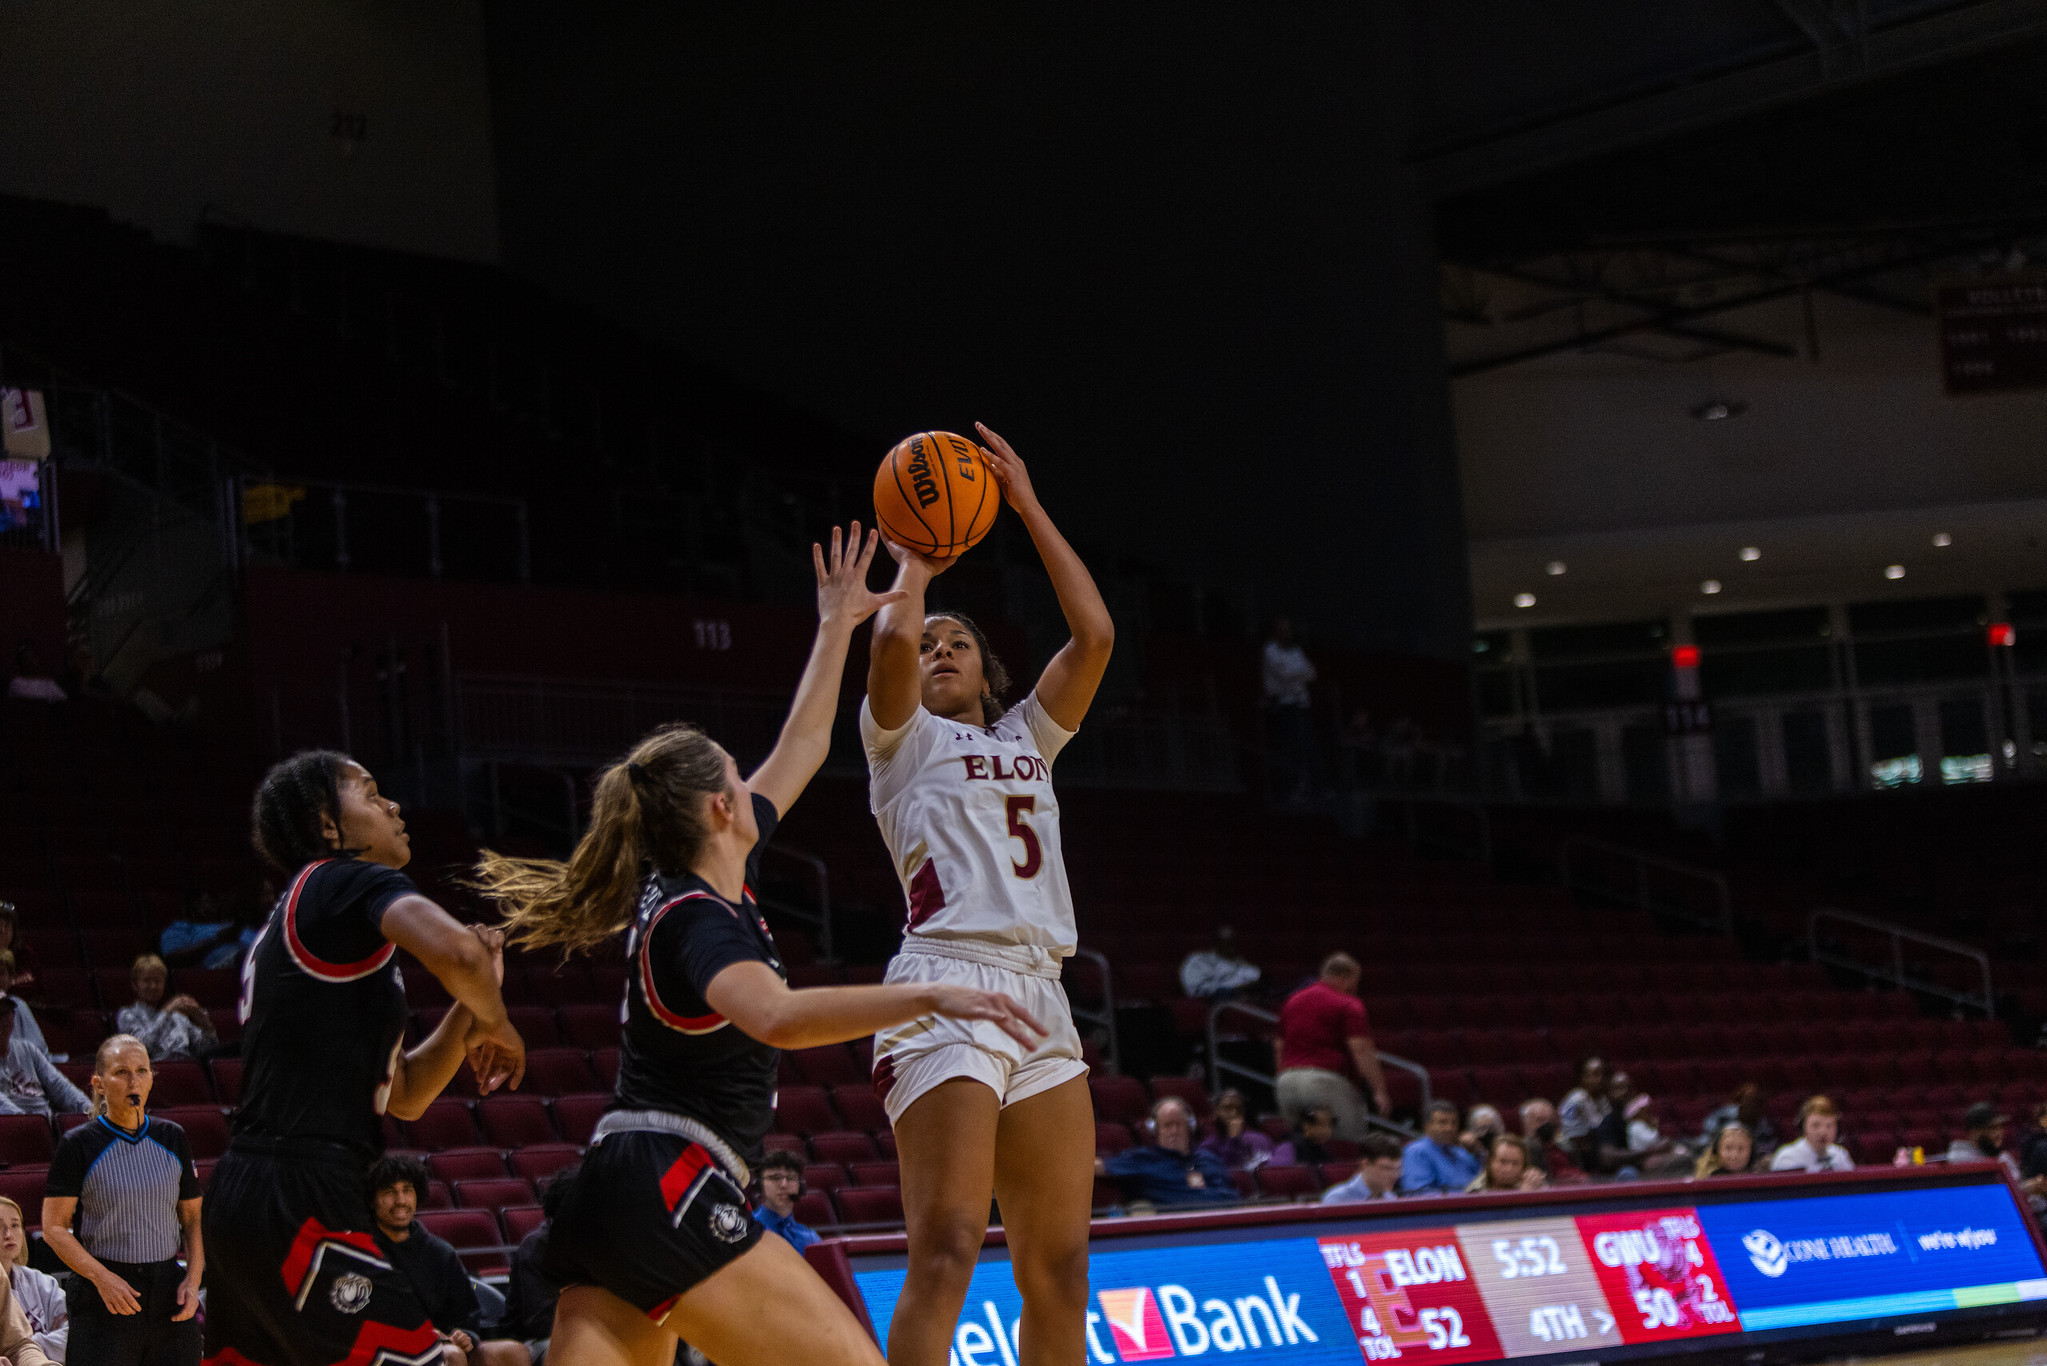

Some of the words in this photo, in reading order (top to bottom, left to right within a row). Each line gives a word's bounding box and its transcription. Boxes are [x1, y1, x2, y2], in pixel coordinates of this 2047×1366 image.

[907, 436, 940, 510] Wilson
[693, 620, 731, 650] 113
[960, 755, 1049, 783] ELON
[1004, 794, 1044, 880] 5
[1384, 1244, 1467, 1286] ELON
[1490, 1236, 1567, 1279] 5:52
[1593, 1229, 1660, 1267] GWU
[1684, 1239, 1704, 1268] 4
[1345, 1269, 1367, 1298] 1
[1695, 1274, 1719, 1302] 2
[1157, 1275, 1319, 1356] Bank
[1361, 1306, 1382, 1336] 4
[1528, 1304, 1588, 1342] 4TH
[1634, 1287, 1679, 1329] 50
[1418, 1306, 1471, 1350] 52
[1359, 1335, 1402, 1360] TOL
